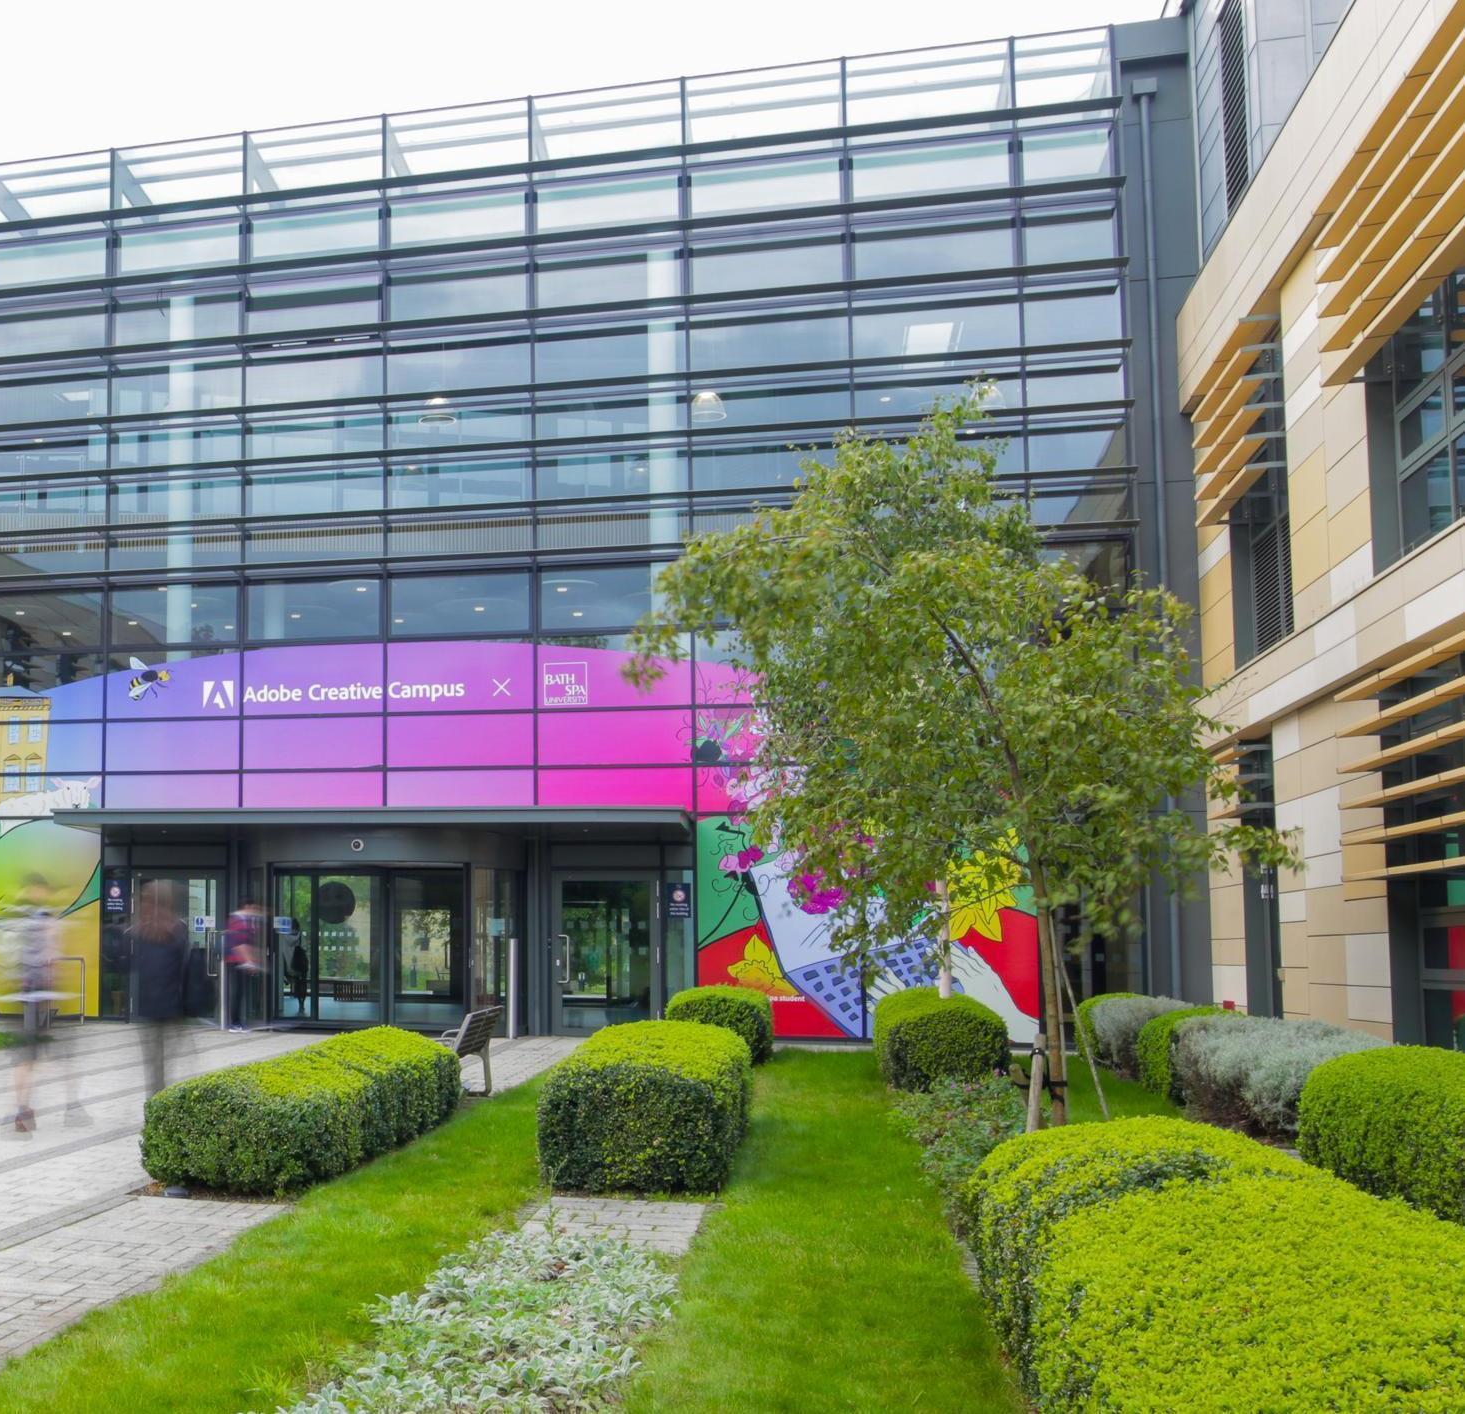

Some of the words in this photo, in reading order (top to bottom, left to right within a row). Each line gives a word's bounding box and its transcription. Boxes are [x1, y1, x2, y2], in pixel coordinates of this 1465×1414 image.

[545, 673, 575, 685] BATH
[243, 685, 302, 703] Adobe
[308, 682, 383, 701] Creative
[388, 681, 465, 702] Campus
[565, 684, 586, 696] SPA
[544, 696, 586, 704] UNIVERSITY
